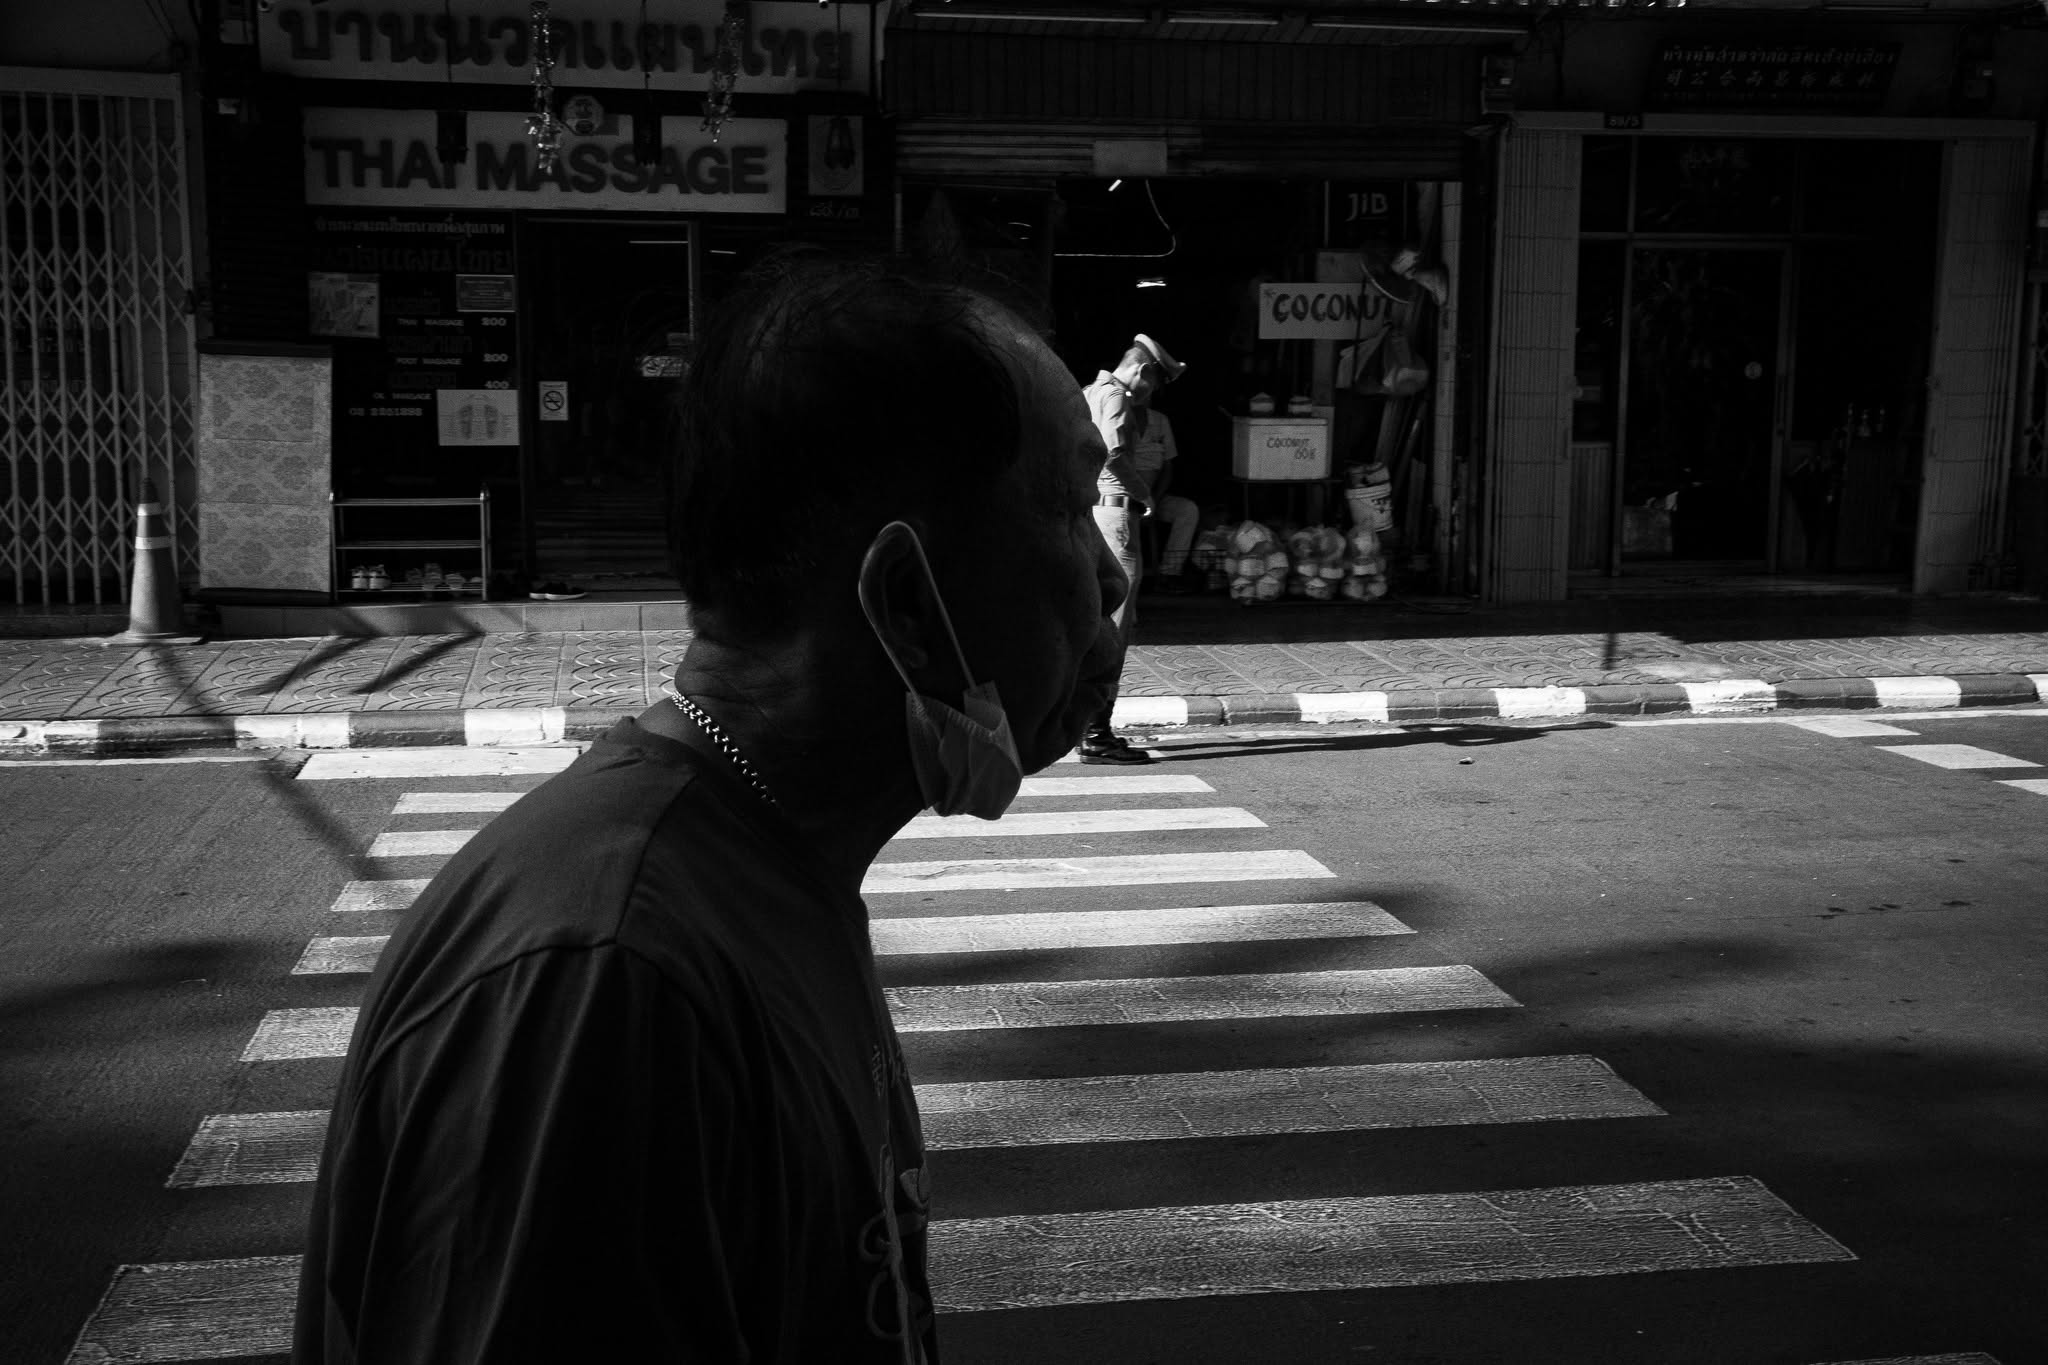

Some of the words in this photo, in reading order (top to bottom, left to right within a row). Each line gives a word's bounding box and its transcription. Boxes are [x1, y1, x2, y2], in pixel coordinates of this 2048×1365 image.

[278, 0, 853, 80] บานนวดแผนไทย
[308, 138, 458, 190] THAI
[475, 141, 769, 195] MASSAGE
